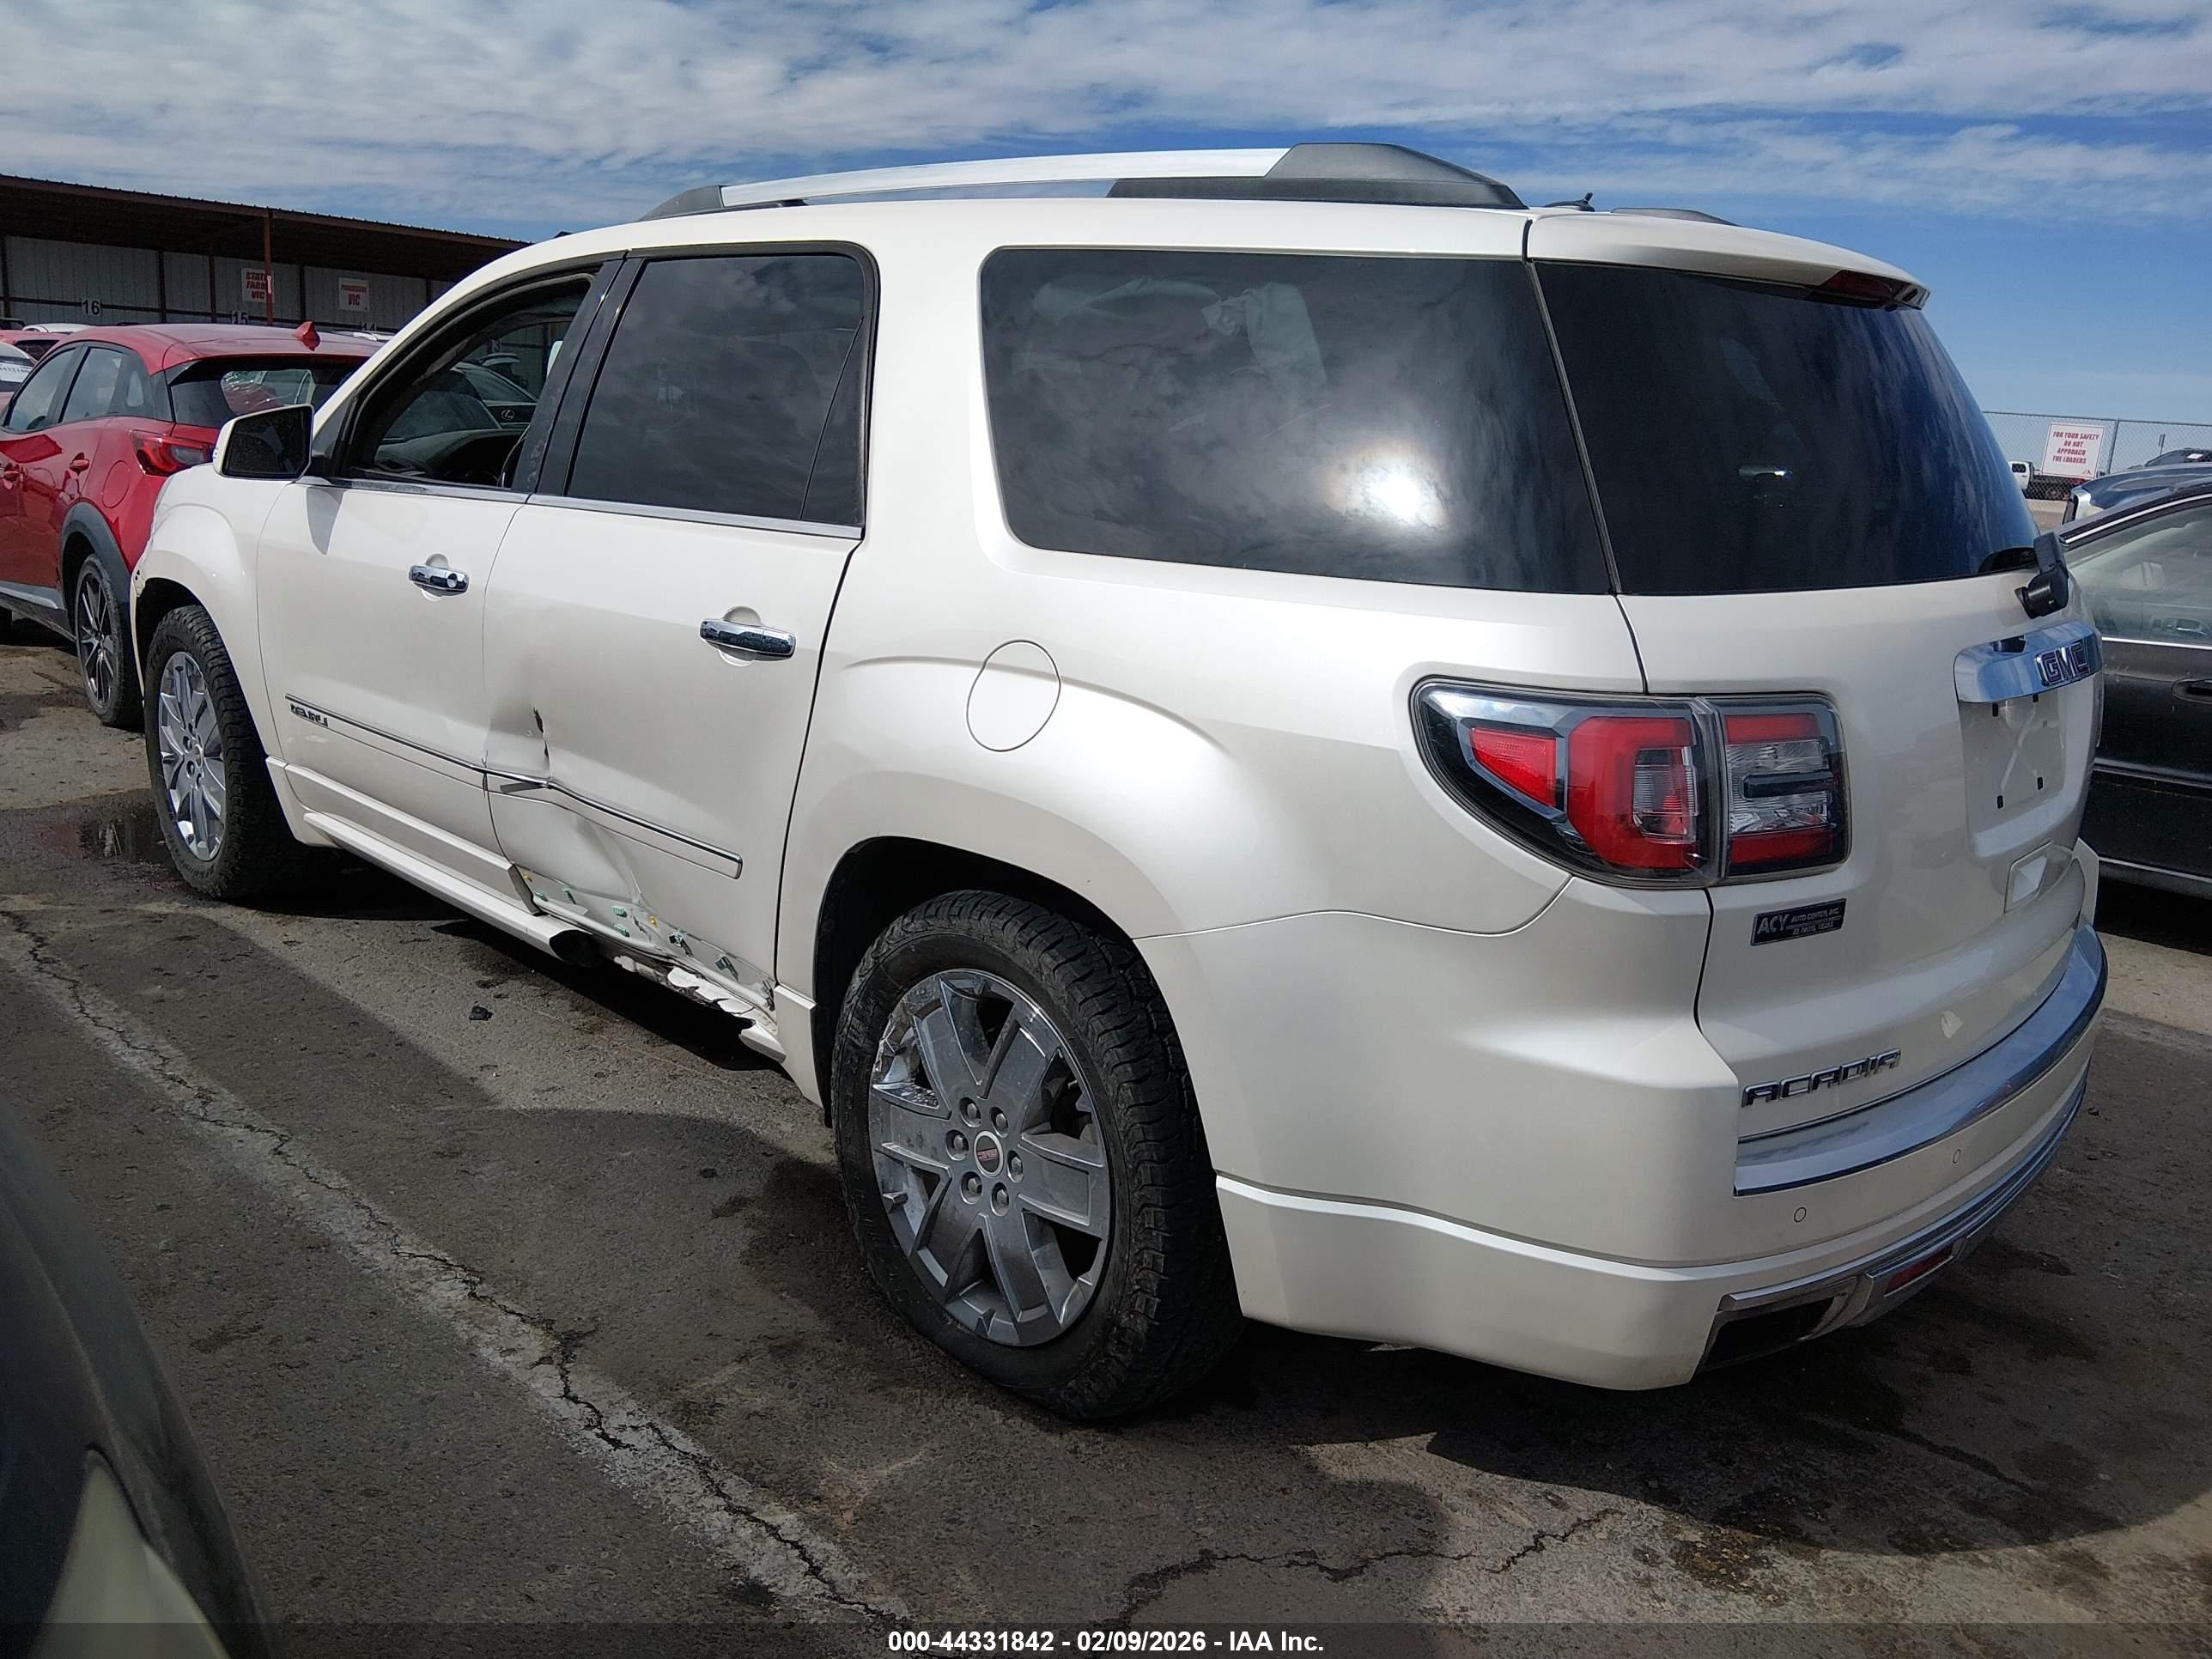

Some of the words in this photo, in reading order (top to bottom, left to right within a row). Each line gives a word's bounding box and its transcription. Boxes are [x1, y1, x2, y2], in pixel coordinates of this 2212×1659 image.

[252, 290, 265, 299] VIC
[349, 294, 360, 306] VIC
[82, 301, 100, 315] 16
[233, 311, 248, 325] 15
[2038, 641, 2090, 685] GMC
[1757, 914, 1790, 934] ACY
[1790, 914, 1807, 922] AUTO
[1818, 921, 1833, 930] TEXAS
[1741, 1048, 1901, 1107] ACADIA
